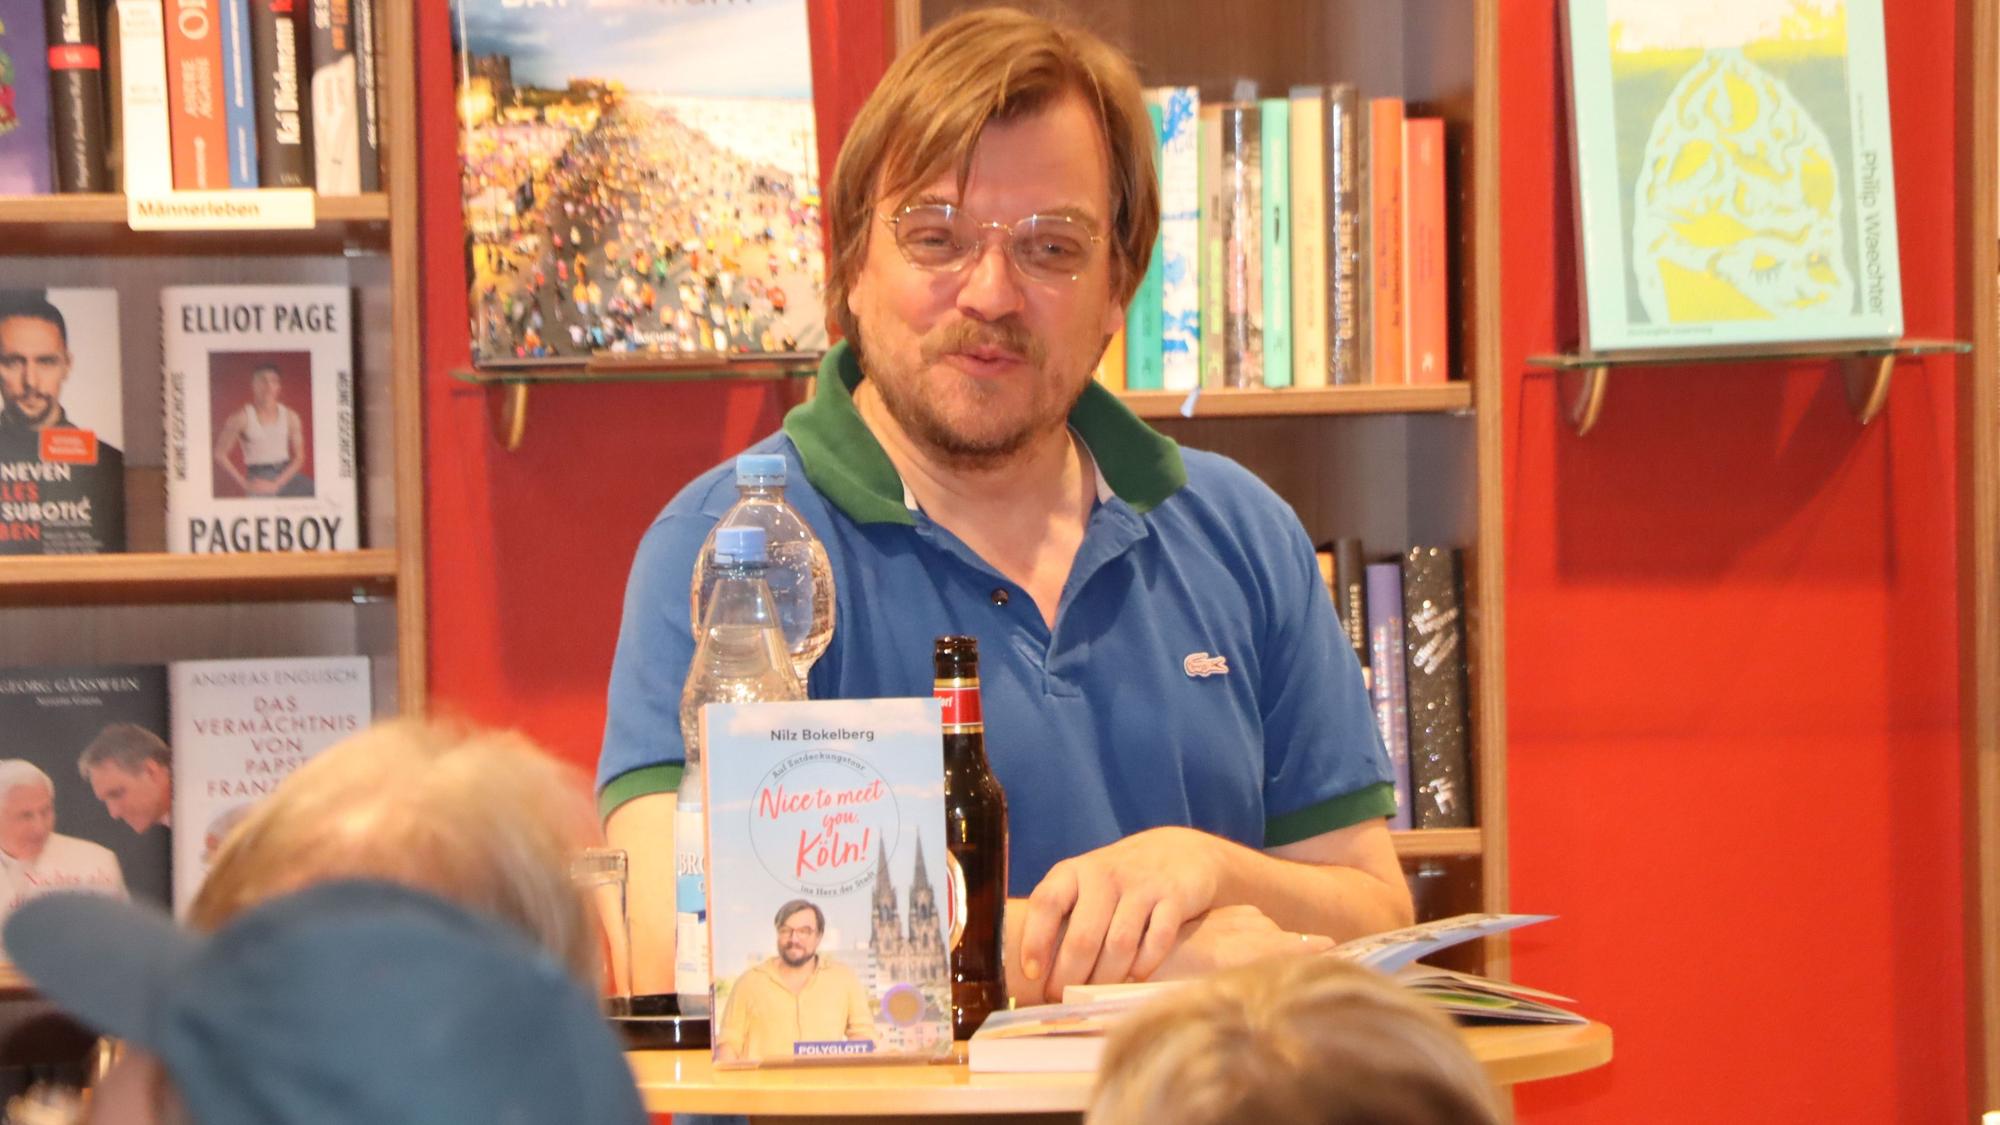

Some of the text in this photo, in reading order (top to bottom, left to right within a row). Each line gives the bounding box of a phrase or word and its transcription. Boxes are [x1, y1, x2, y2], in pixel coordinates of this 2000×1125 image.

[1859, 151, 1881, 209] Philip
[137, 201, 261, 219] Männerleben
[1864, 211, 1884, 317] Waechter
[181, 303, 337, 333] ELLIOT PAGE
[1, 462, 71, 481] NEVEN
[1, 496, 92, 522] SUBOTIĆ
[190, 516, 343, 554] PAGEBOY
[192, 671, 269, 686] ANDREAS
[254, 696, 298, 713] DAS
[251, 737, 303, 753] VON
[770, 728, 875, 743] Nilz Bokelberg
[772, 764, 788, 779] Auf
[759, 778, 884, 819] Nice to meet
[796, 827, 870, 879] Köln!
[798, 1044, 868, 1055] POLYGLOTT
